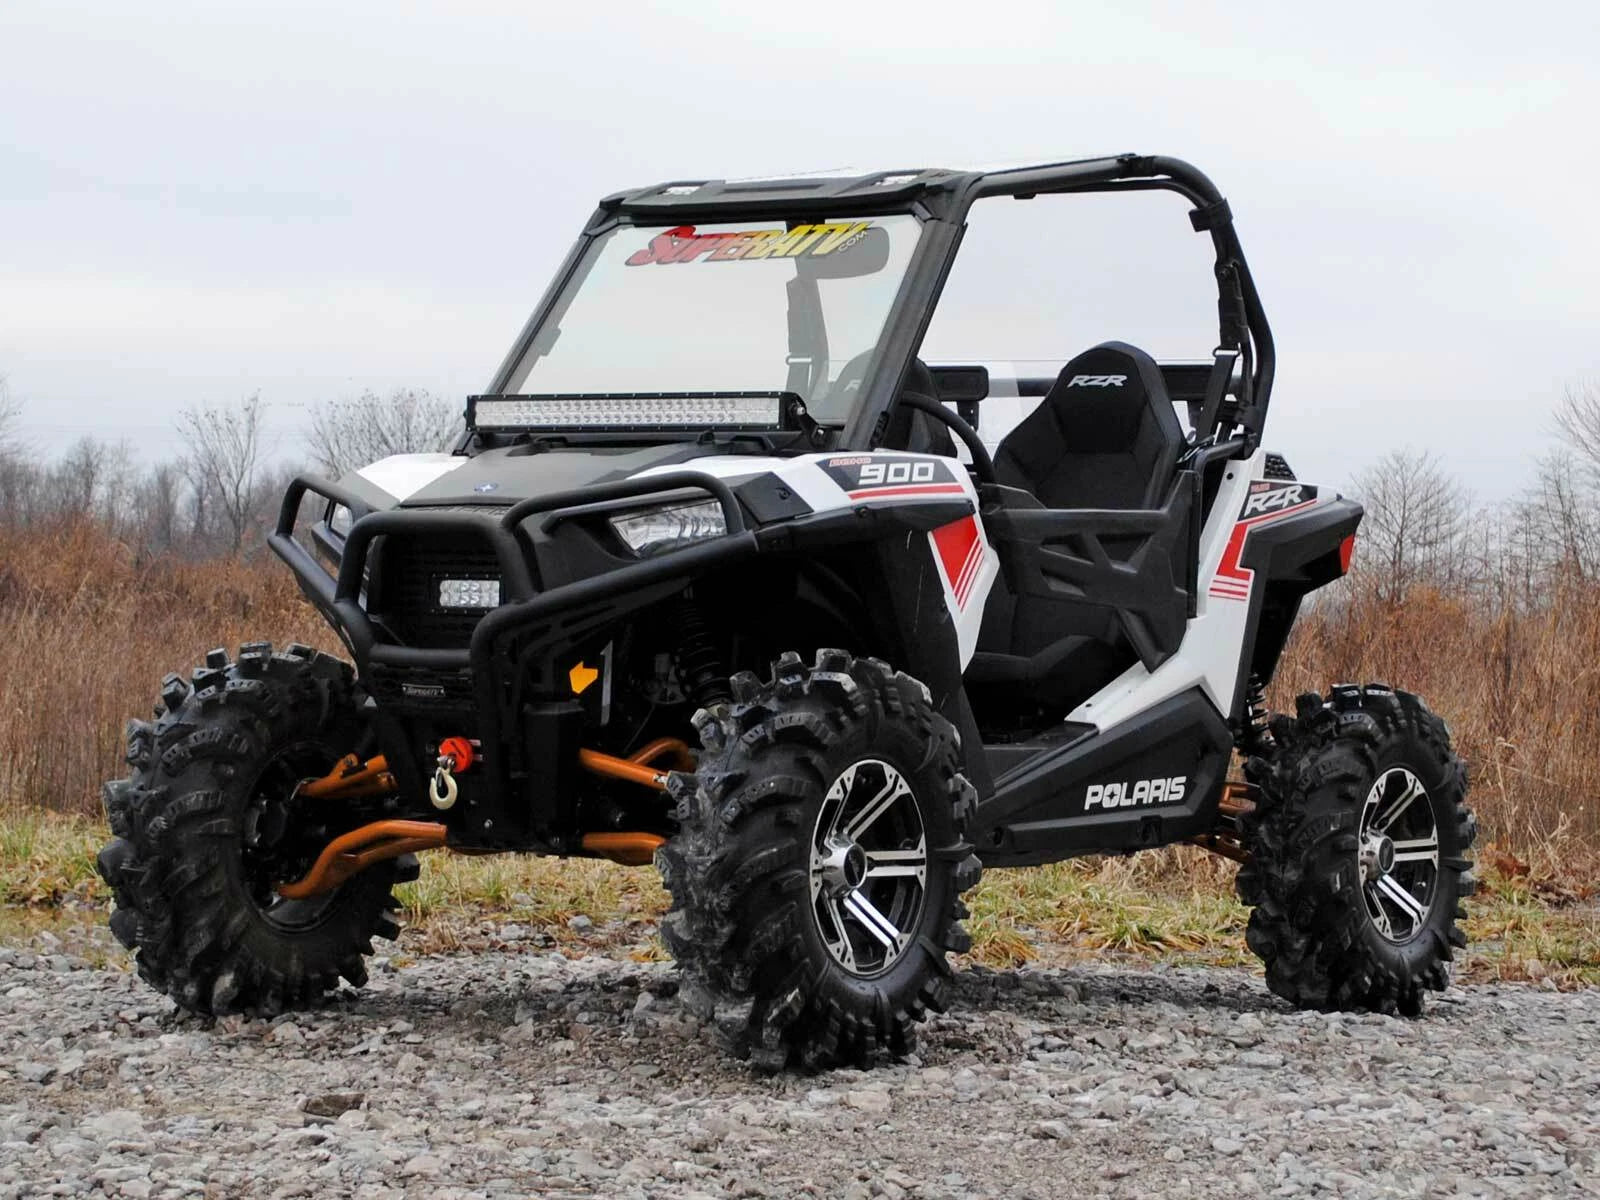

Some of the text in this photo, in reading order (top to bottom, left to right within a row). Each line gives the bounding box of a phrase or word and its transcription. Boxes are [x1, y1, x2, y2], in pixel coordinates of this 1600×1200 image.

[1067, 374, 1128, 388] RZR
[858, 462, 935, 485] 900
[1244, 485, 1302, 517] RZR
[1084, 776, 1187, 810] POLARIS
